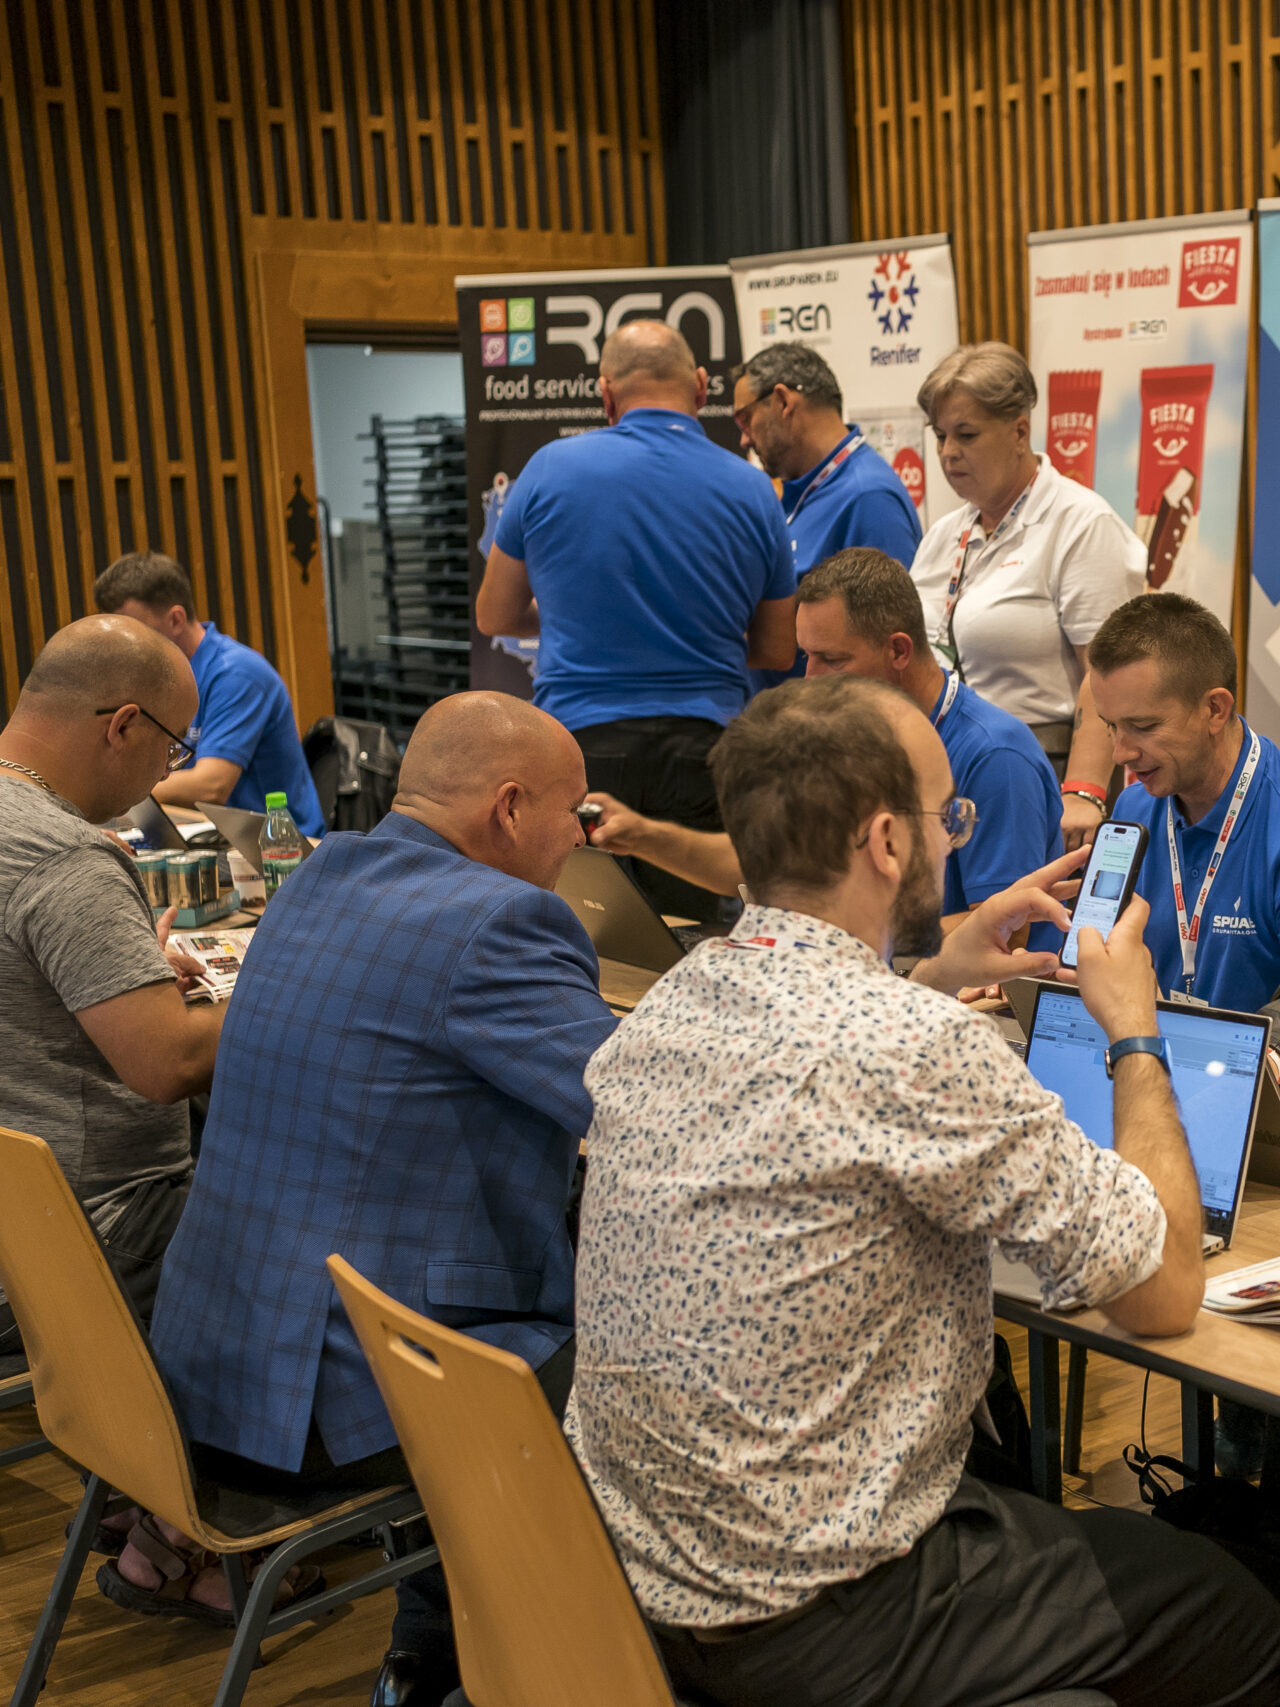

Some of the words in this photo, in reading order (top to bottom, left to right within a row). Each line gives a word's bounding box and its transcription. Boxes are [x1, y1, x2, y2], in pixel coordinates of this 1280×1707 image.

[1184, 245, 1236, 271] FIESTA
[485, 374, 530, 401] food
[1051, 411, 1094, 432] FIESTA
[1149, 402, 1195, 427] FIESTA
